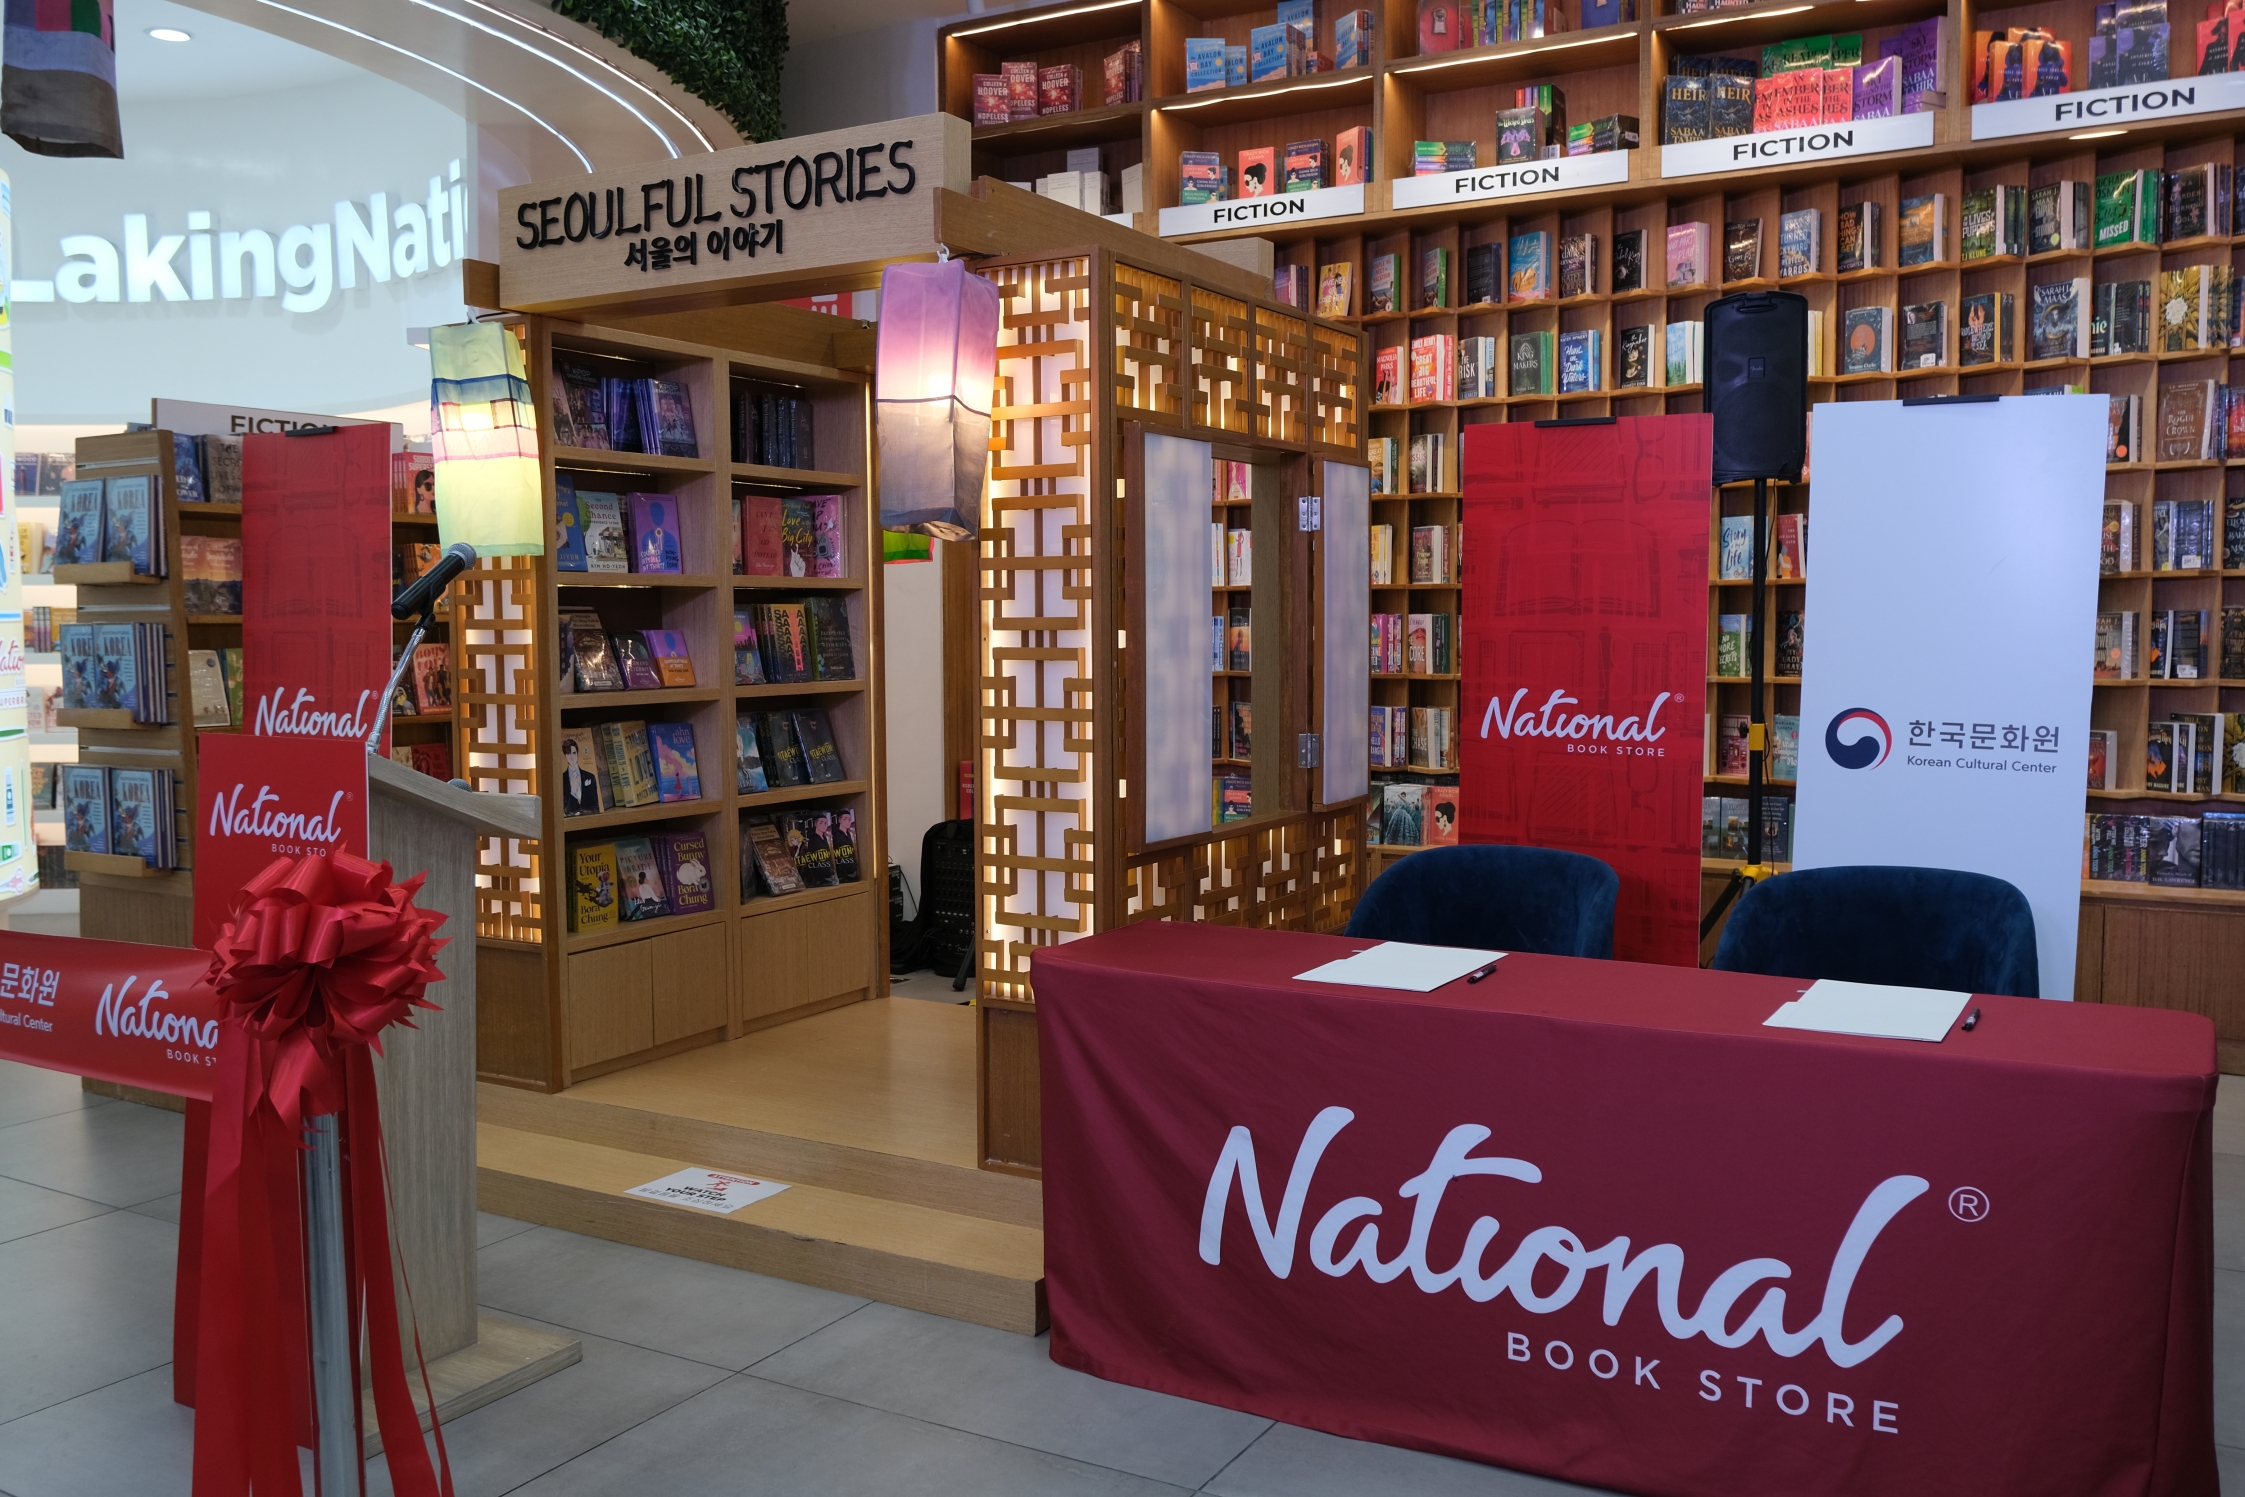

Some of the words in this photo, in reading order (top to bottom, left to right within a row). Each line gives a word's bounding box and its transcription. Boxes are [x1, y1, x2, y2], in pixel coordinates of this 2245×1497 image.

[1261, 37, 1283, 49] AVALON
[1911, 33, 1928, 49] SKY
[1198, 51, 1222, 60] AVALON
[1263, 49, 1274, 57] BAY
[1255, 54, 1283, 68] COLLECTION
[1191, 69, 1222, 77] COLLECTION
[1903, 67, 1935, 86] SABAA
[1042, 78, 1068, 90] HOOVER
[1774, 82, 1820, 98] EMBER
[1904, 79, 1935, 96] TAHIR
[978, 87, 1008, 96] HOOVER
[1672, 87, 1706, 101] HEIR
[1717, 86, 1752, 105] HEIR
[1854, 91, 1892, 112] STORM
[2055, 87, 2195, 122] FICTION
[1042, 105, 1068, 115] HOPELESS
[1778, 103, 1819, 116] ASHES
[1503, 118, 1521, 128] Wicked
[1521, 116, 1534, 126] Years
[1733, 131, 1853, 160] FICTION
[1456, 167, 1559, 193] FICTION
[516, 173, 722, 251] SEOULFUL
[730, 140, 916, 218] STORIES
[2031, 189, 2052, 201] SARAH
[1214, 199, 1305, 223] FICTION
[1841, 220, 1854, 229] BAD
[1969, 210, 1990, 226] LIVES
[2099, 220, 2129, 241] MISSED
[624, 231, 697, 272] 서울의
[707, 219, 783, 261] 이야기
[1679, 236, 1694, 248] PART
[1840, 235, 1855, 245] CAN
[1840, 245, 1854, 253] GET
[1969, 249, 1986, 260] KLUNE
[1780, 265, 1808, 278] YARROS
[2040, 286, 2065, 296] SARAH
[2043, 294, 2067, 304] MAAS
[1411, 337, 1423, 349] EMILY
[1424, 336, 1436, 346] HENRY
[1517, 351, 1534, 361] KING
[1565, 345, 1583, 355] Hunt
[1377, 353, 1397, 364] MAGNOLIA
[1416, 353, 1432, 365] GREAT
[1461, 355, 1469, 365] THE
[1513, 360, 1538, 370] MAKERS
[1380, 361, 1394, 370] PARKS
[1459, 363, 1475, 379] RISK
[1411, 376, 1437, 388] BEAUTIFUL
[1414, 388, 1426, 398] LIFE
[231, 415, 332, 434] FICT
[70, 490, 98, 513] KOREA
[117, 488, 146, 511] KOREA
[586, 502, 613, 511] Second
[585, 511, 617, 520] Chance
[781, 509, 801, 526] Love
[781, 527, 794, 546] Big
[796, 527, 813, 547] City
[1722, 527, 1747, 549] Story
[1725, 549, 1742, 571] Life
[1721, 634, 1729, 644] NO
[71, 637, 92, 656] KORE
[103, 636, 132, 656] KOREA
[255, 687, 370, 738] National
[1481, 688, 1670, 742] National
[675, 727, 690, 735] ahn
[1909, 720, 2060, 753] 한국문화원
[673, 735, 691, 744] love
[1782, 741, 1795, 749] Wall
[1568, 744, 1608, 754] BOOK
[1617, 746, 1665, 757] STORE
[1907, 755, 1951, 768] Korean
[1956, 758, 2007, 771] Cultural
[2011, 761, 2057, 773] Center
[74, 780, 100, 799] KOREA
[122, 783, 150, 802] KOREA
[210, 783, 344, 842] National
[272, 844, 301, 854] BOOK
[306, 848, 326, 857] STO
[673, 839, 704, 851] Cursed
[579, 853, 602, 864] Your
[619, 853, 653, 863] PICTURE
[677, 851, 706, 861] Bunny
[579, 862, 610, 876] Utopia
[626, 863, 652, 873] BRIDE
[678, 885, 698, 895] Bora
[679, 894, 708, 905] Chung
[581, 905, 600, 915] Bora
[581, 912, 609, 925] Chung
[96, 975, 218, 1049] Nationa
[23, 1014, 53, 1032] Center
[166, 1049, 199, 1065] BOOK
[666, 1187, 696, 1196] YOUR
[697, 1193, 726, 1201] STEP
[684, 1186, 726, 1197] WATCH
[1198, 1106, 1930, 1369] National
[1506, 1331, 1661, 1390] BOOK
[1697, 1369, 1901, 1435] STORE
